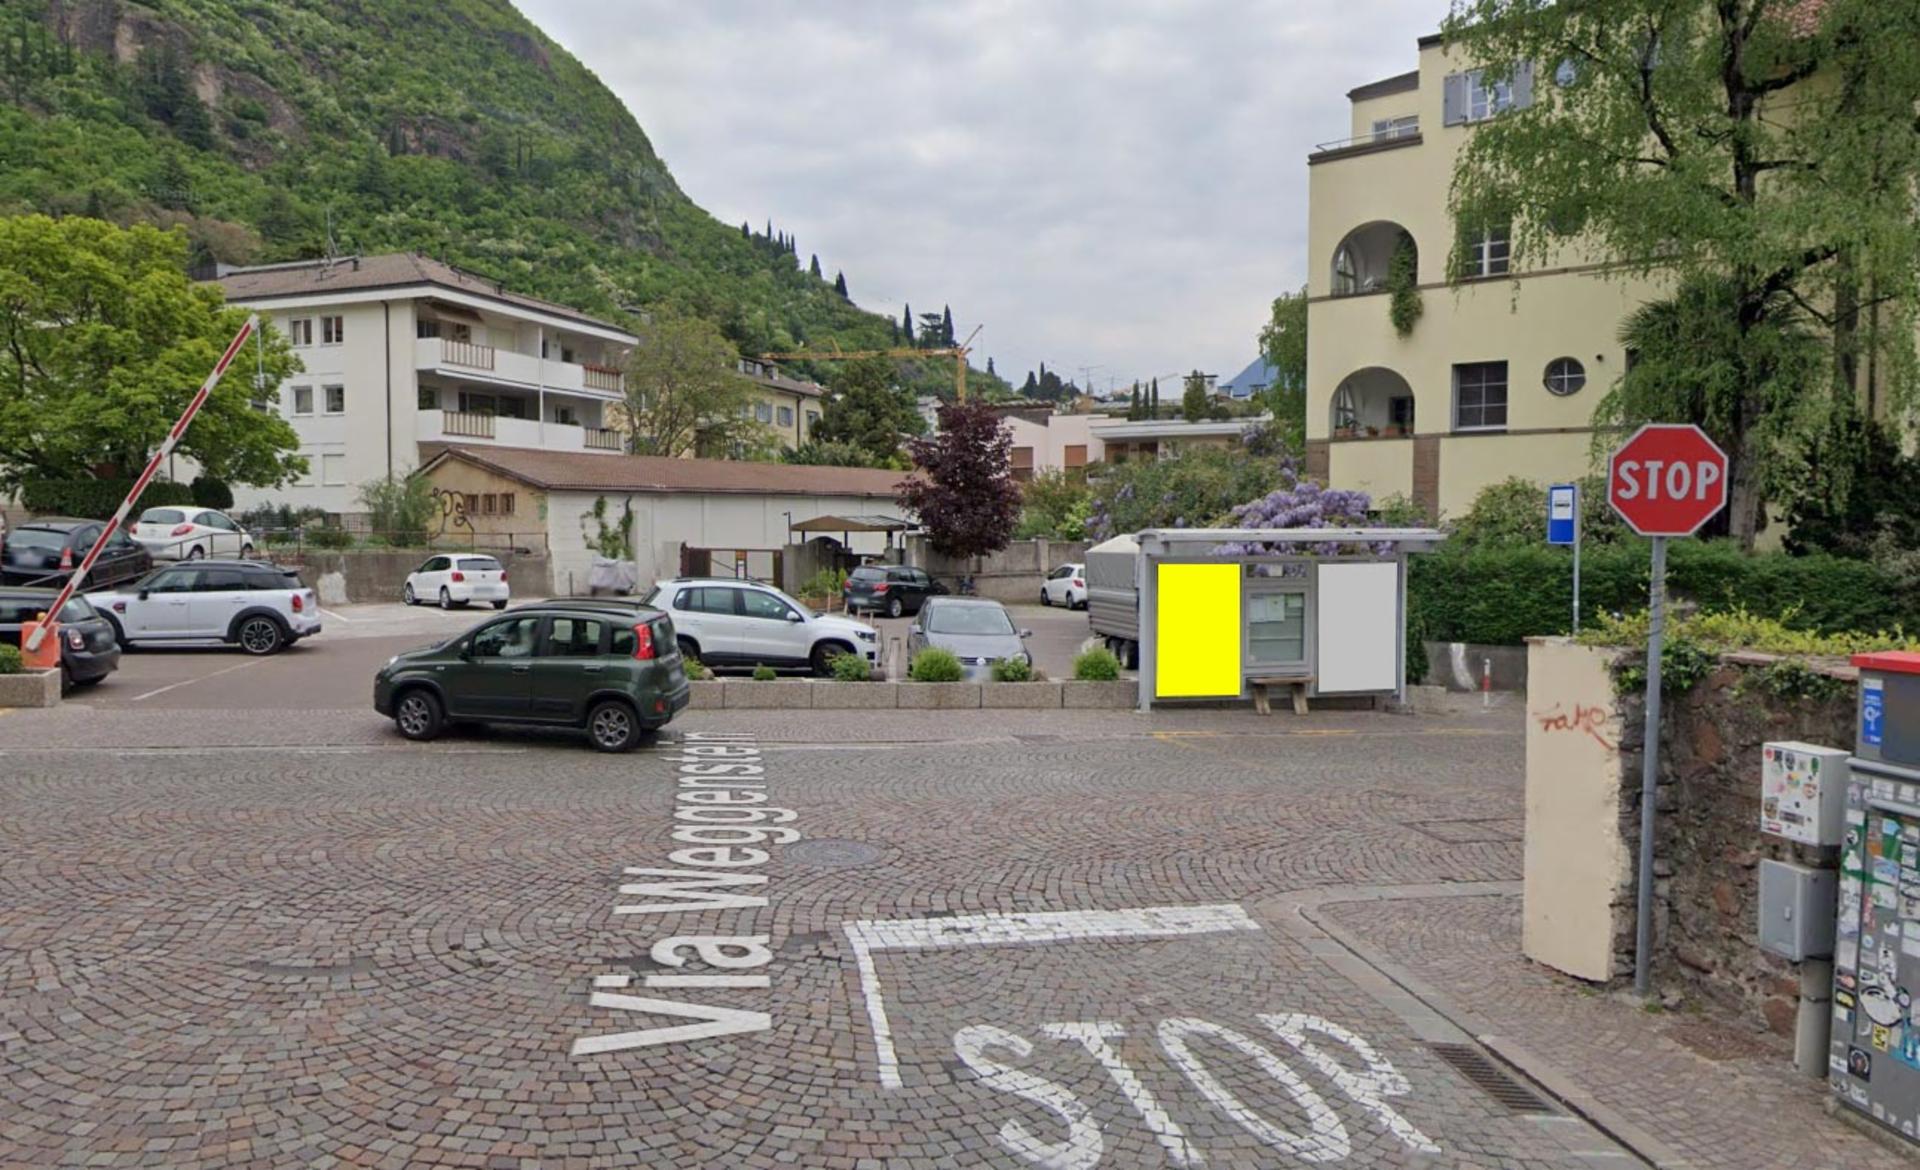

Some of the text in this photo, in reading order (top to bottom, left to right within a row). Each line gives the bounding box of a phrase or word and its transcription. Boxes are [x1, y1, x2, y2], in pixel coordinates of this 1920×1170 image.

[1617, 460, 1720, 500] STOP
[571, 732, 800, 1057] Via Weggenstein
[953, 1012, 1442, 1170] STOP
